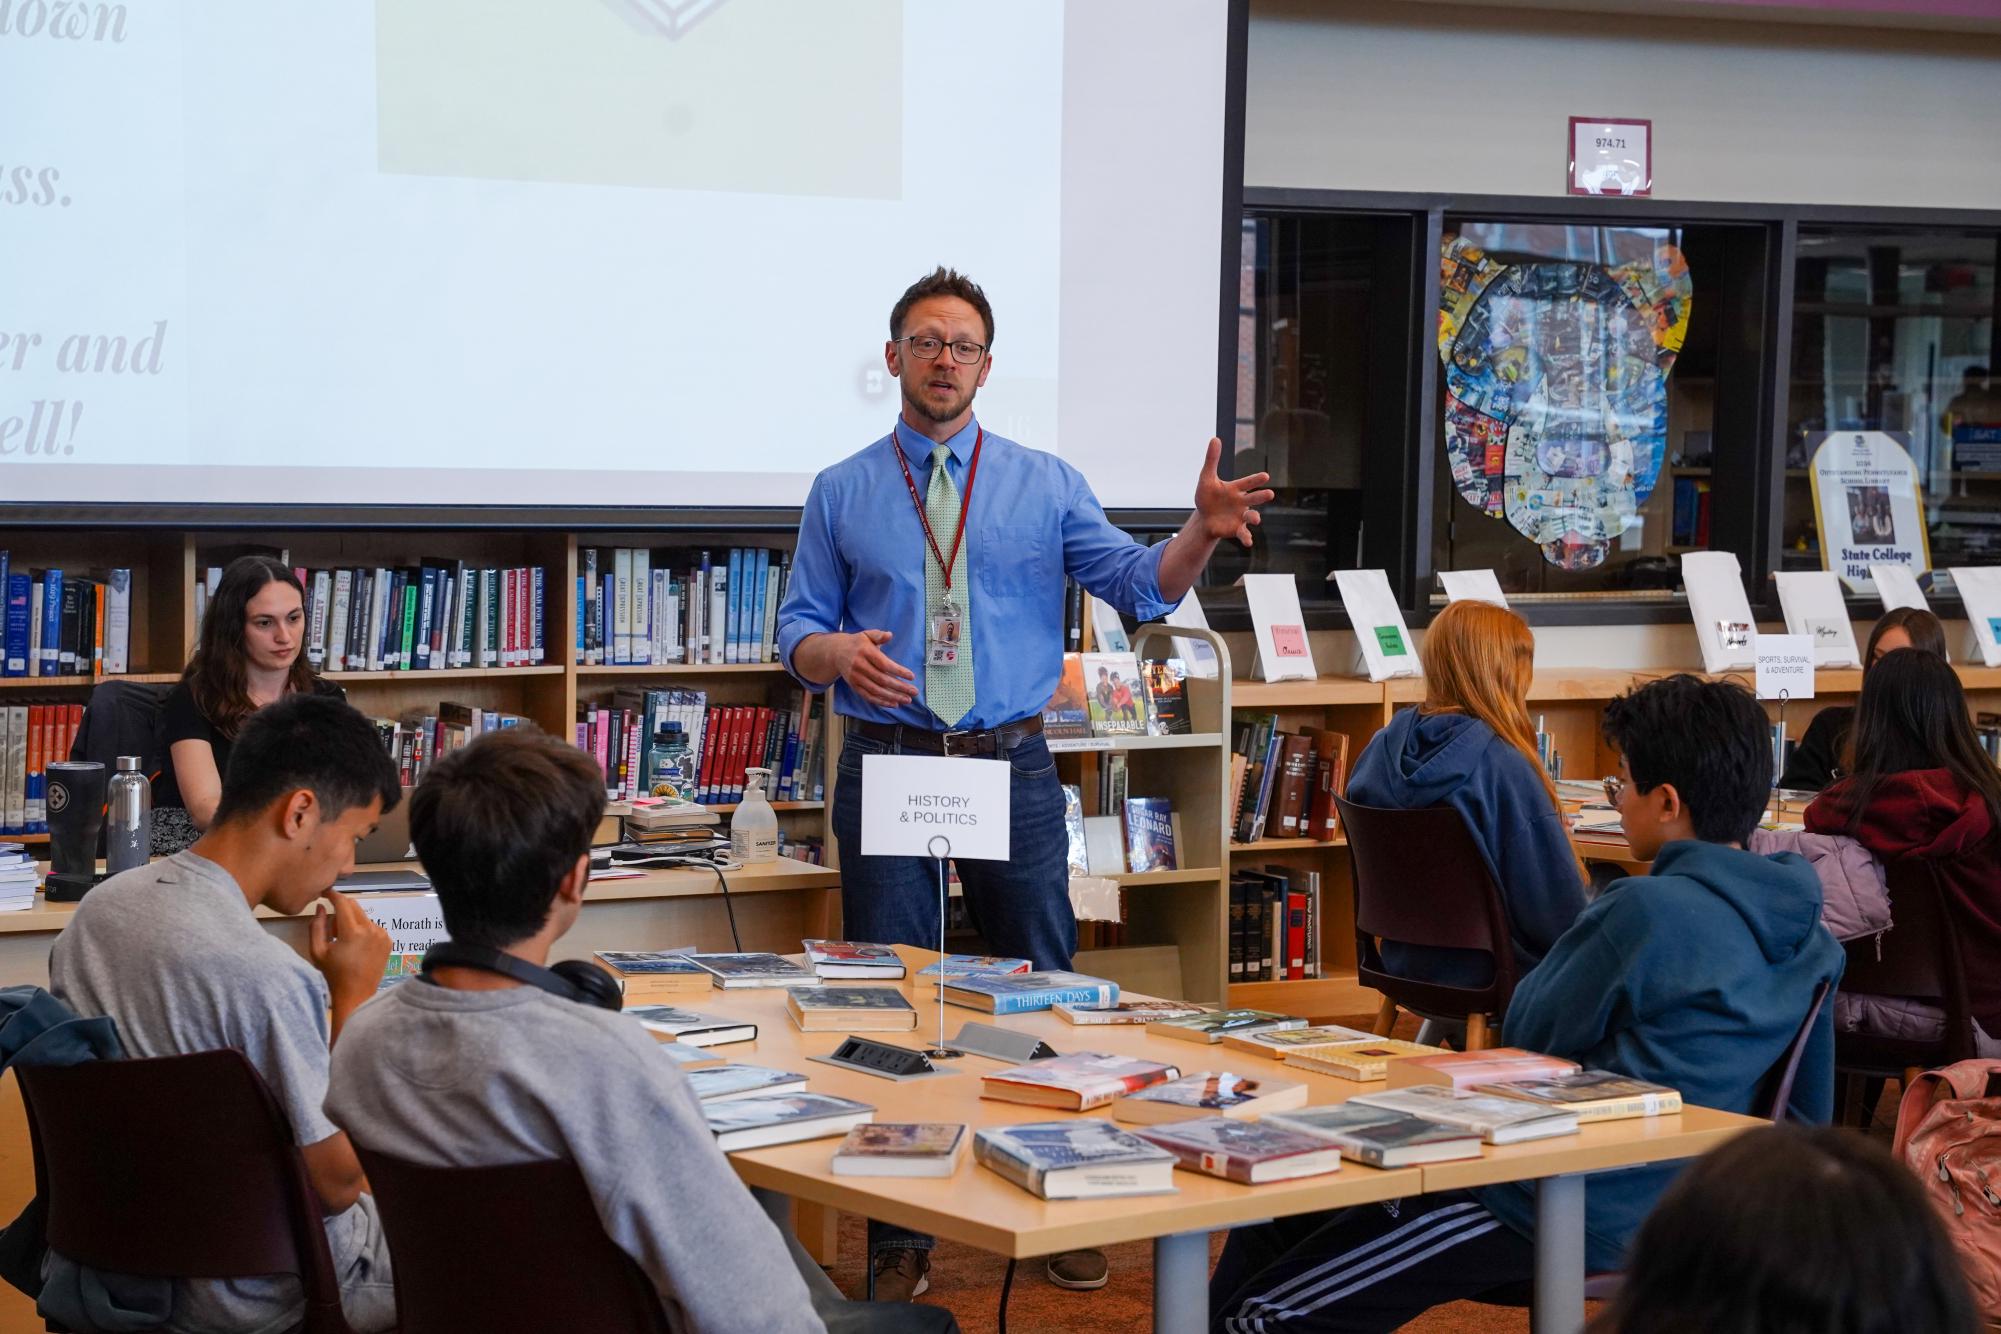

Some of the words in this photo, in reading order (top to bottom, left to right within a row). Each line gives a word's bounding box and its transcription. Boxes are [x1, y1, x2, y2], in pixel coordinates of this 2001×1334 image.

[1595, 137, 1627, 149] 974.71
[56, 319, 168, 375] and
[1841, 547, 1871, 561] State
[1872, 548, 1912, 563] College
[1846, 565, 1871, 580] Hig
[48, 583, 57, 598] 1619
[618, 577, 626, 592] GREAT
[636, 578, 644, 593] GREAT
[47, 600, 57, 622] Project
[465, 607, 472, 617] OF
[489, 607, 496, 617] OF
[618, 594, 626, 623] DEPRESSION
[464, 621, 472, 635] THE
[1771, 666, 1805, 675] ADVENTURE
[1095, 719, 1145, 731] INSEPARABLE
[908, 793, 970, 809] HISTORY
[900, 810, 909, 824] &
[913, 811, 978, 826] POLITICS
[1154, 811, 1167, 823] RAY
[1128, 814, 1172, 837] LEONARD
[391, 917, 432, 931] Morath
[434, 916, 443, 929] is
[1016, 993, 1063, 1008] THIRTEEN
[1066, 990, 1091, 1004] DAYS
